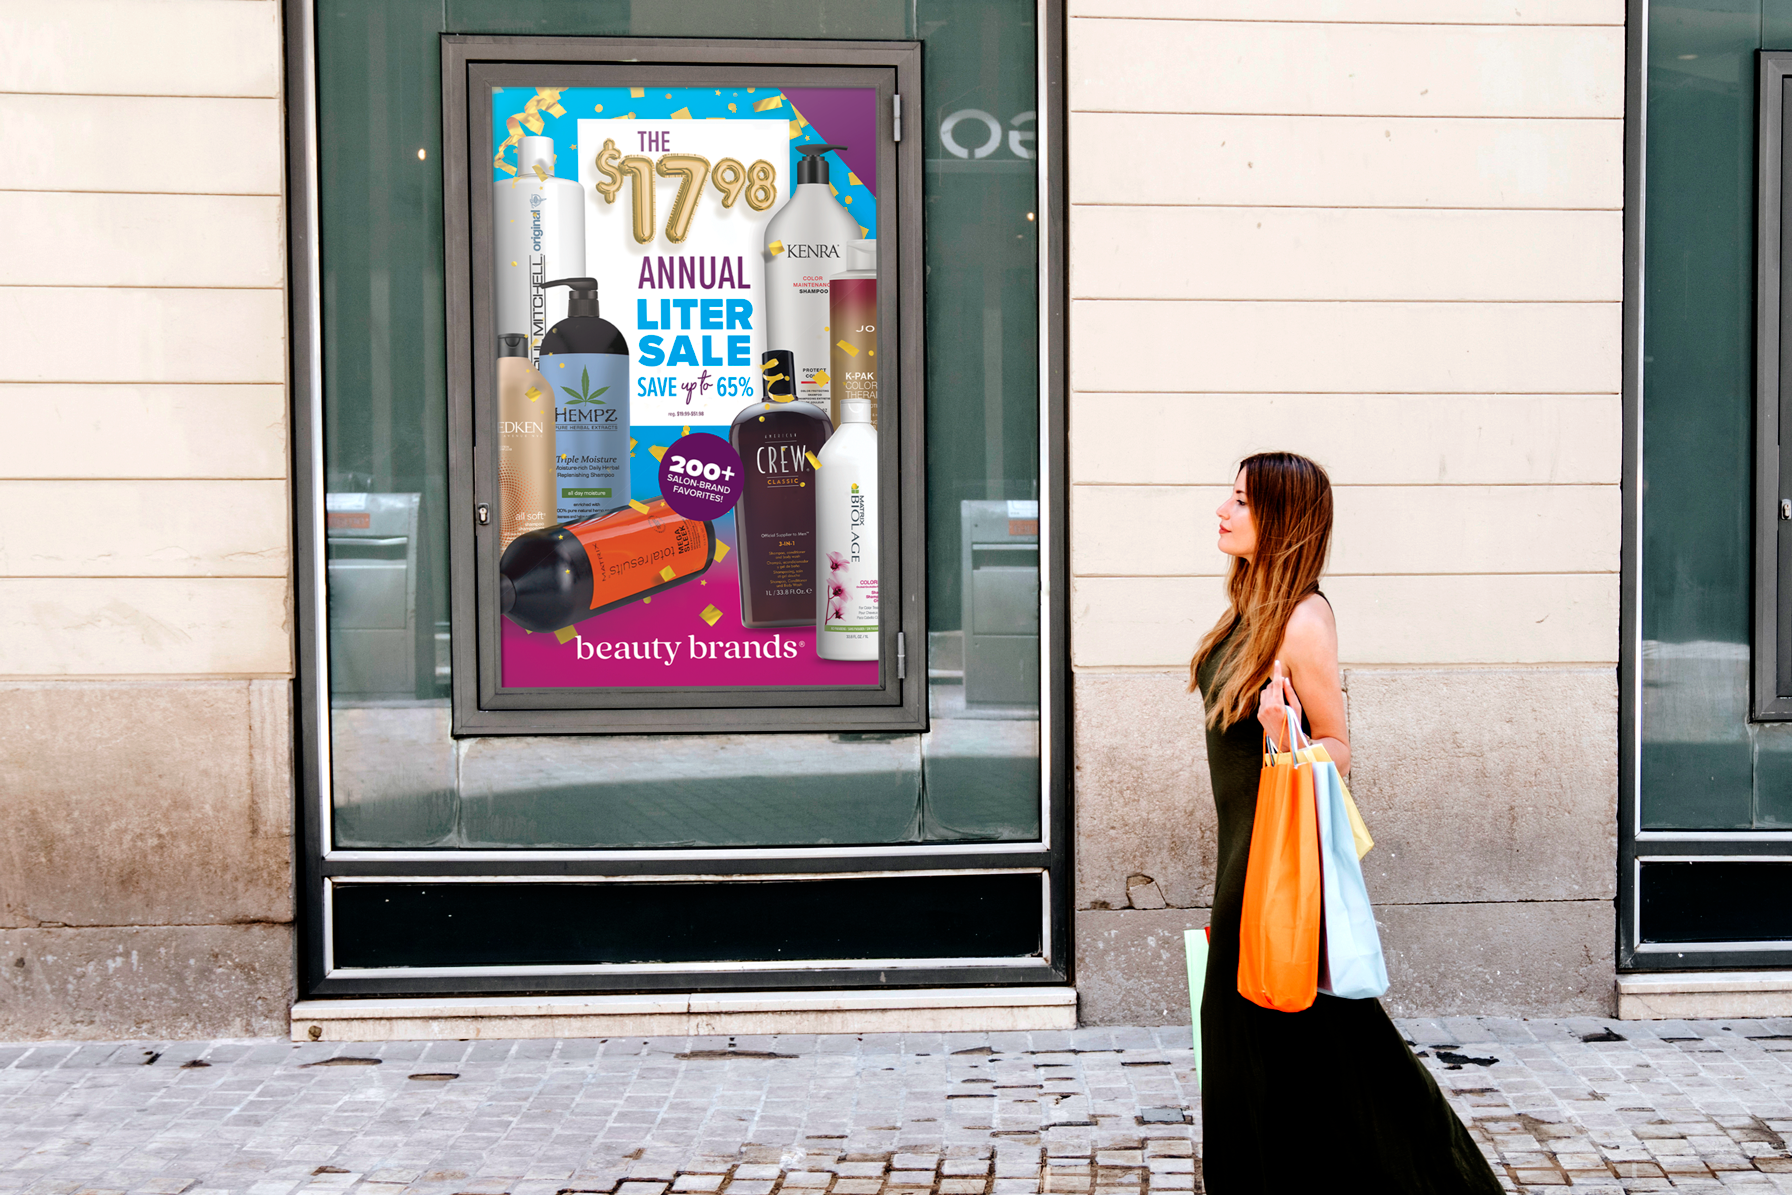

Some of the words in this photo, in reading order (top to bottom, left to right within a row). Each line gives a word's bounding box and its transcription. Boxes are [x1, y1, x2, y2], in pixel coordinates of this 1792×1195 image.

[637, 131, 670, 152] THE
[530, 210, 544, 252] original
[787, 244, 841, 258] KENRA
[638, 256, 751, 289] ANNUAL
[532, 256, 544, 337] MITCHELL
[637, 299, 753, 330] LITER
[638, 334, 751, 367] SALE
[637, 377, 677, 397] SAVE
[681, 381, 697, 405] up
[697, 369, 714, 396] to
[717, 376, 754, 397] 65%
[845, 372, 874, 380] K-PAK
[845, 381, 877, 390] COLOR
[555, 407, 618, 422] HEMPZ
[581, 455, 617, 463] Moisture
[669, 455, 735, 481] 200+
[756, 445, 806, 474] CREW
[667, 473, 731, 494] SALON-BRAND
[672, 485, 724, 503] FAVORITES!
[515, 512, 525, 520] all
[527, 511, 544, 520] soft
[851, 495, 860, 562] BIOLAGE
[674, 528, 684, 555] MEGA
[679, 525, 690, 552] SLEEK
[575, 635, 682, 666] beauty
